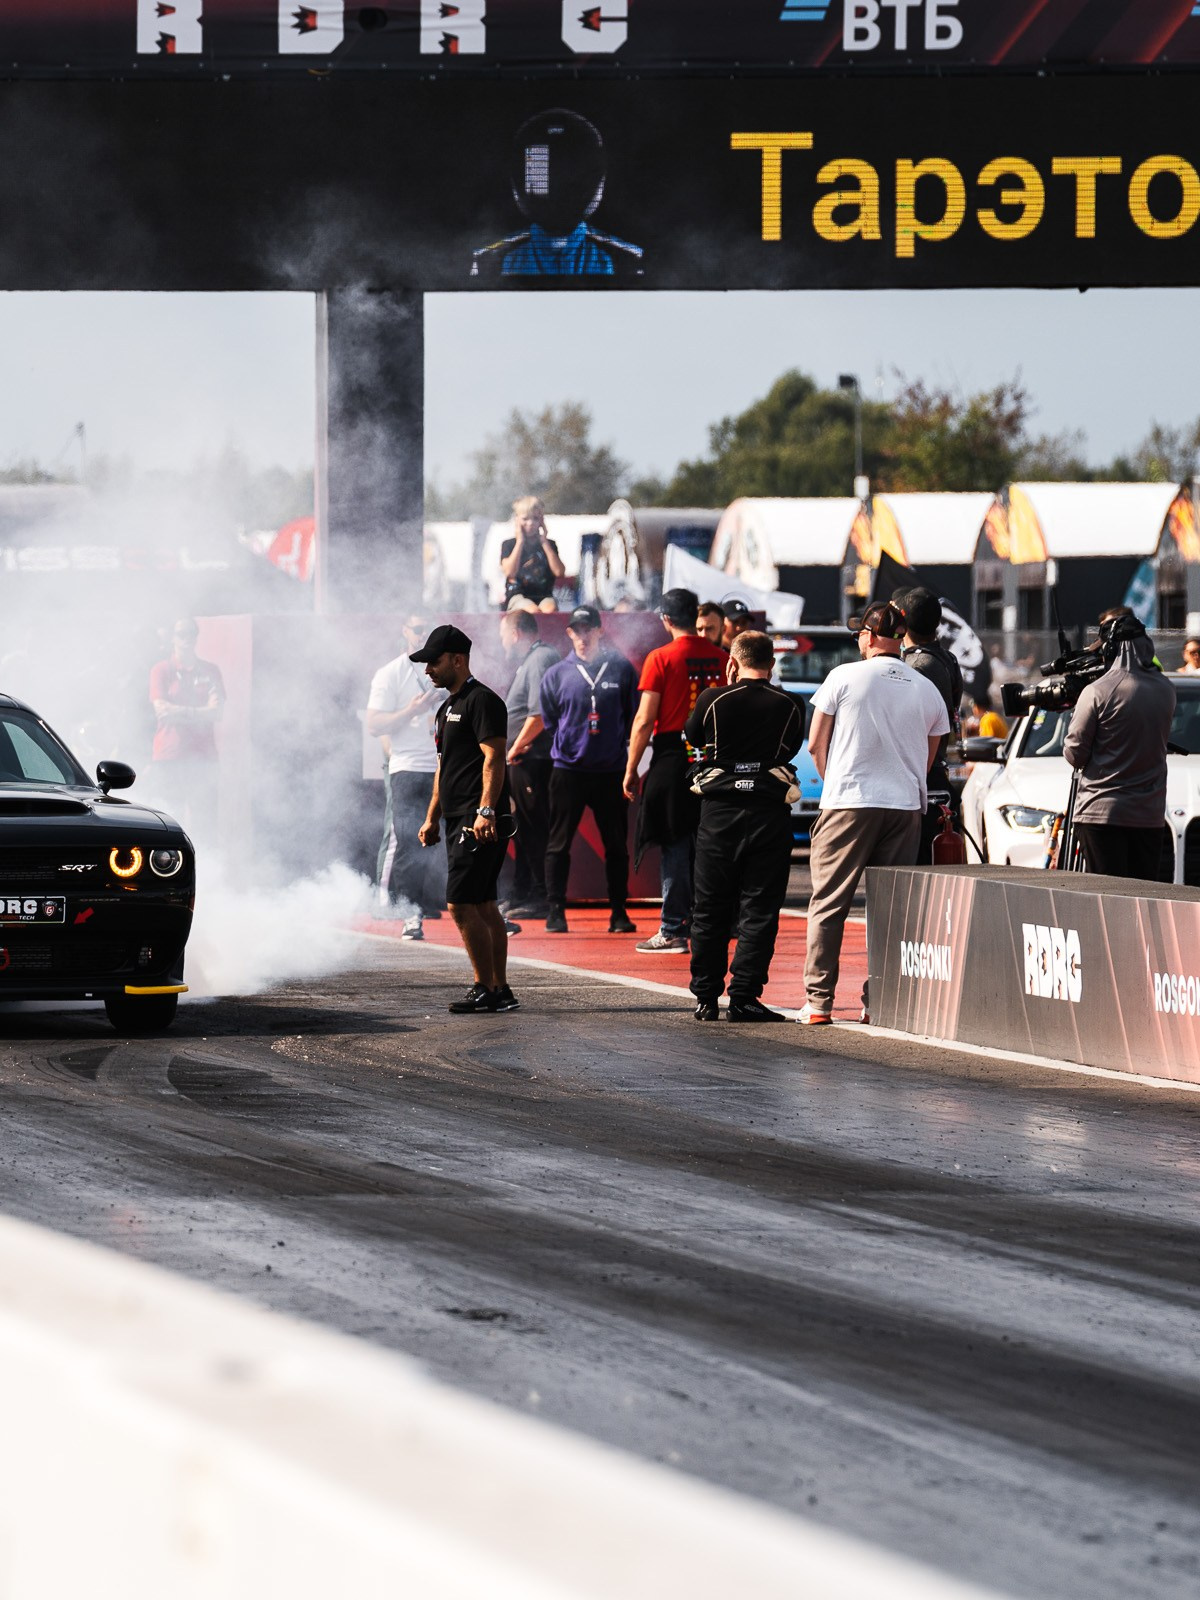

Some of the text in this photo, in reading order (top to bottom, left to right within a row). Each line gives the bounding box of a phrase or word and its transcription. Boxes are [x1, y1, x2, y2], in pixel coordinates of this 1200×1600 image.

[841, 0, 964, 52] ВТБ
[731, 131, 1200, 258] Тарэто
[734, 779, 755, 791] OMP
[58, 864, 98, 873] SRT
[900, 940, 952, 982] ROSGONKI
[1022, 922, 1083, 1003] RDRC
